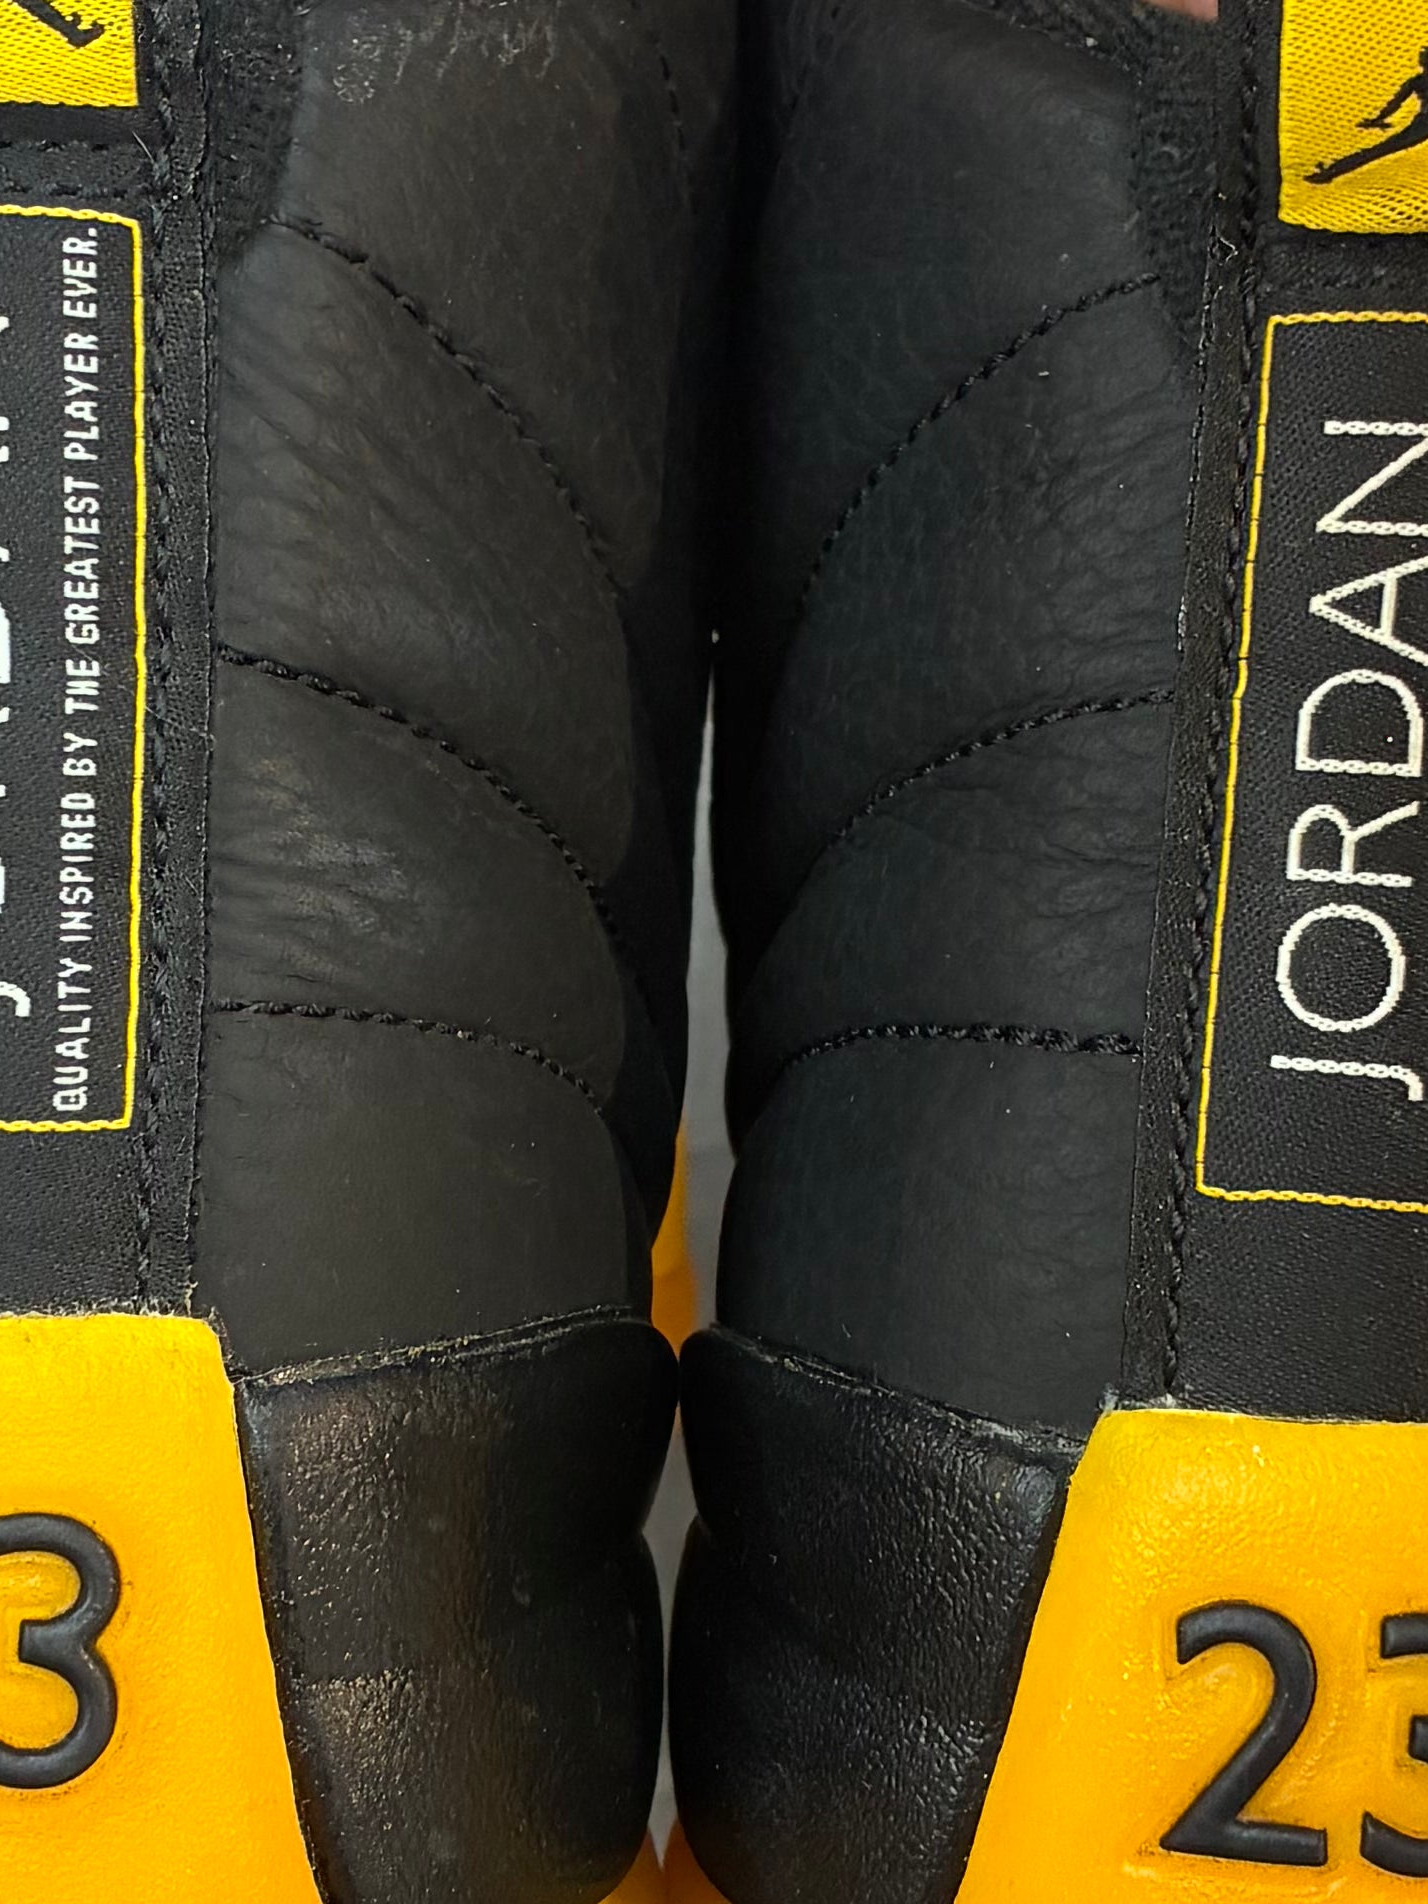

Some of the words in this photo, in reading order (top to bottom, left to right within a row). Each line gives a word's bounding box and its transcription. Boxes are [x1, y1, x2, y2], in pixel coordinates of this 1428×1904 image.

[61, 227, 98, 319] EVER.
[63, 332, 100, 461] PLAYER
[63, 475, 101, 645] GREATEST
[64, 658, 102, 715] THE
[61, 731, 99, 777] BY
[58, 792, 97, 943] INSPIRED
[52, 957, 93, 1112] QUALITY
